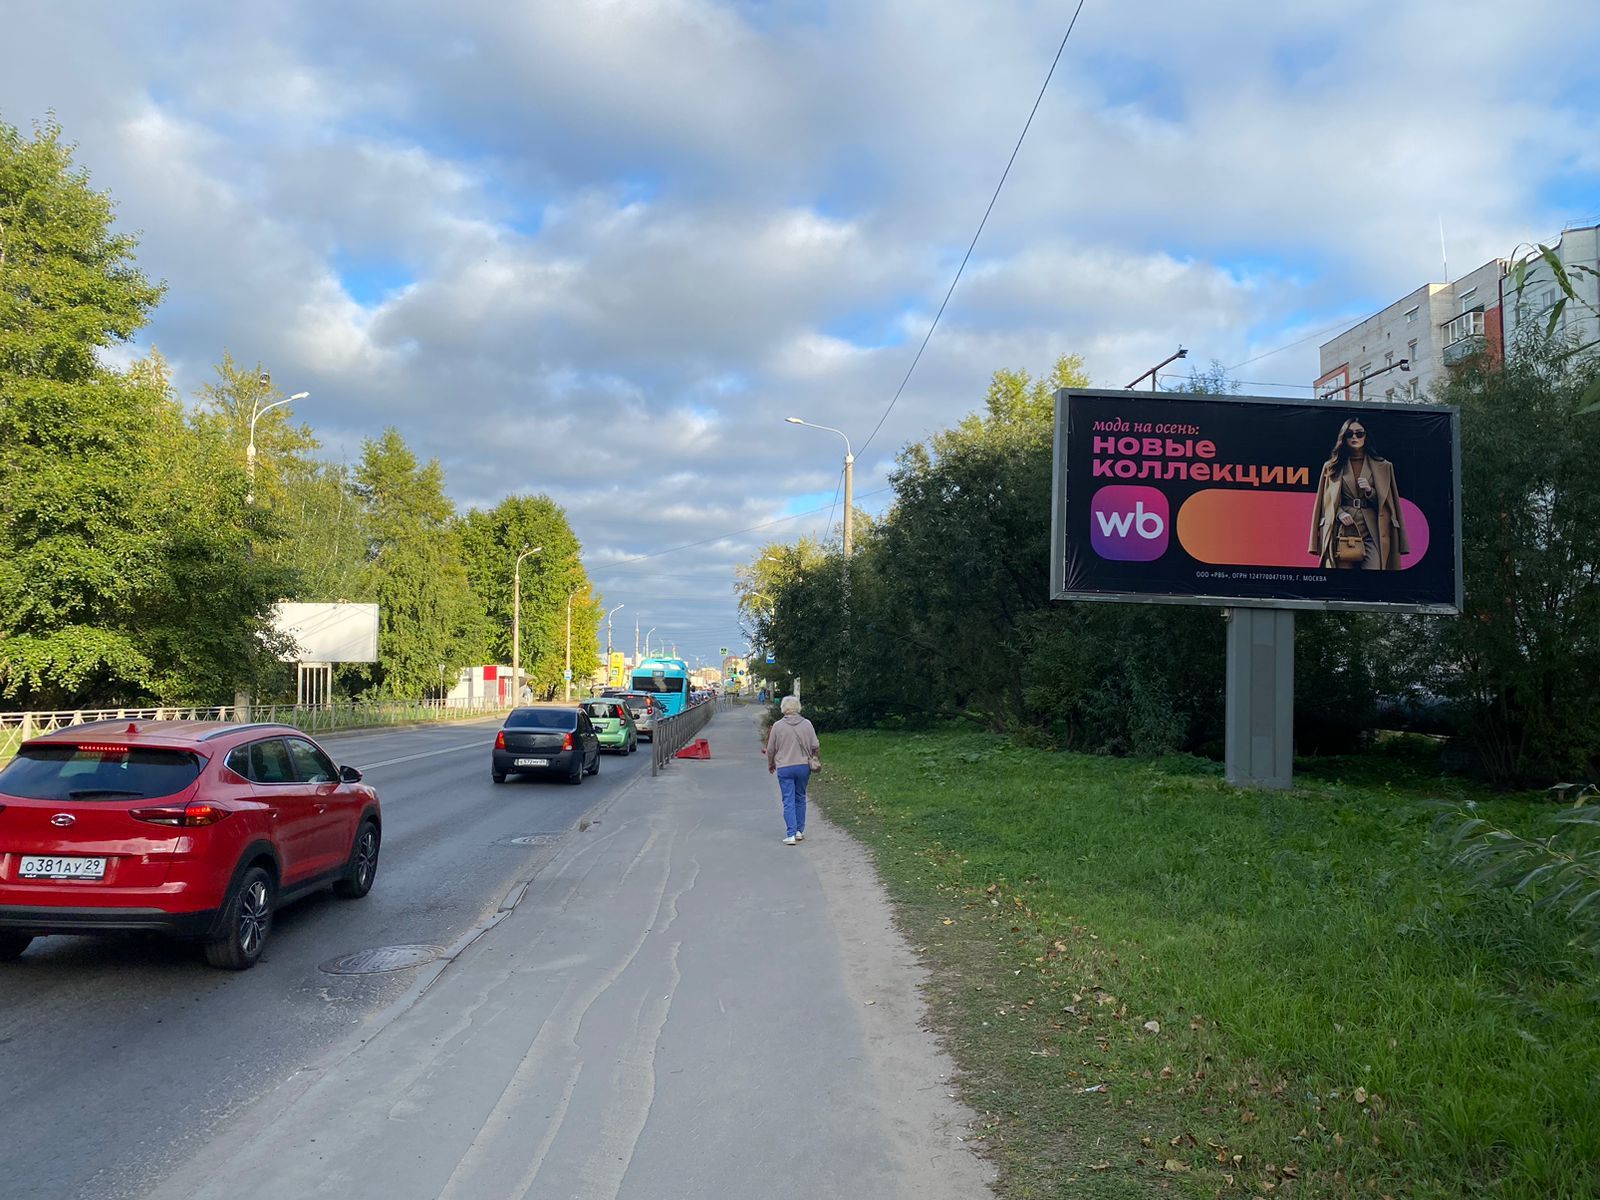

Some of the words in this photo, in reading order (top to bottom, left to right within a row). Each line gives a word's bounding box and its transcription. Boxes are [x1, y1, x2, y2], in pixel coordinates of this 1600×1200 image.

[1092, 417, 1130, 432] мода
[1133, 423, 1152, 433] на
[1155, 424, 1200, 435] осень:
[1092, 436, 1217, 458] новые
[1092, 459, 1310, 487] коллекции
[1095, 501, 1164, 540] wb
[85, 860, 101, 870] 29
